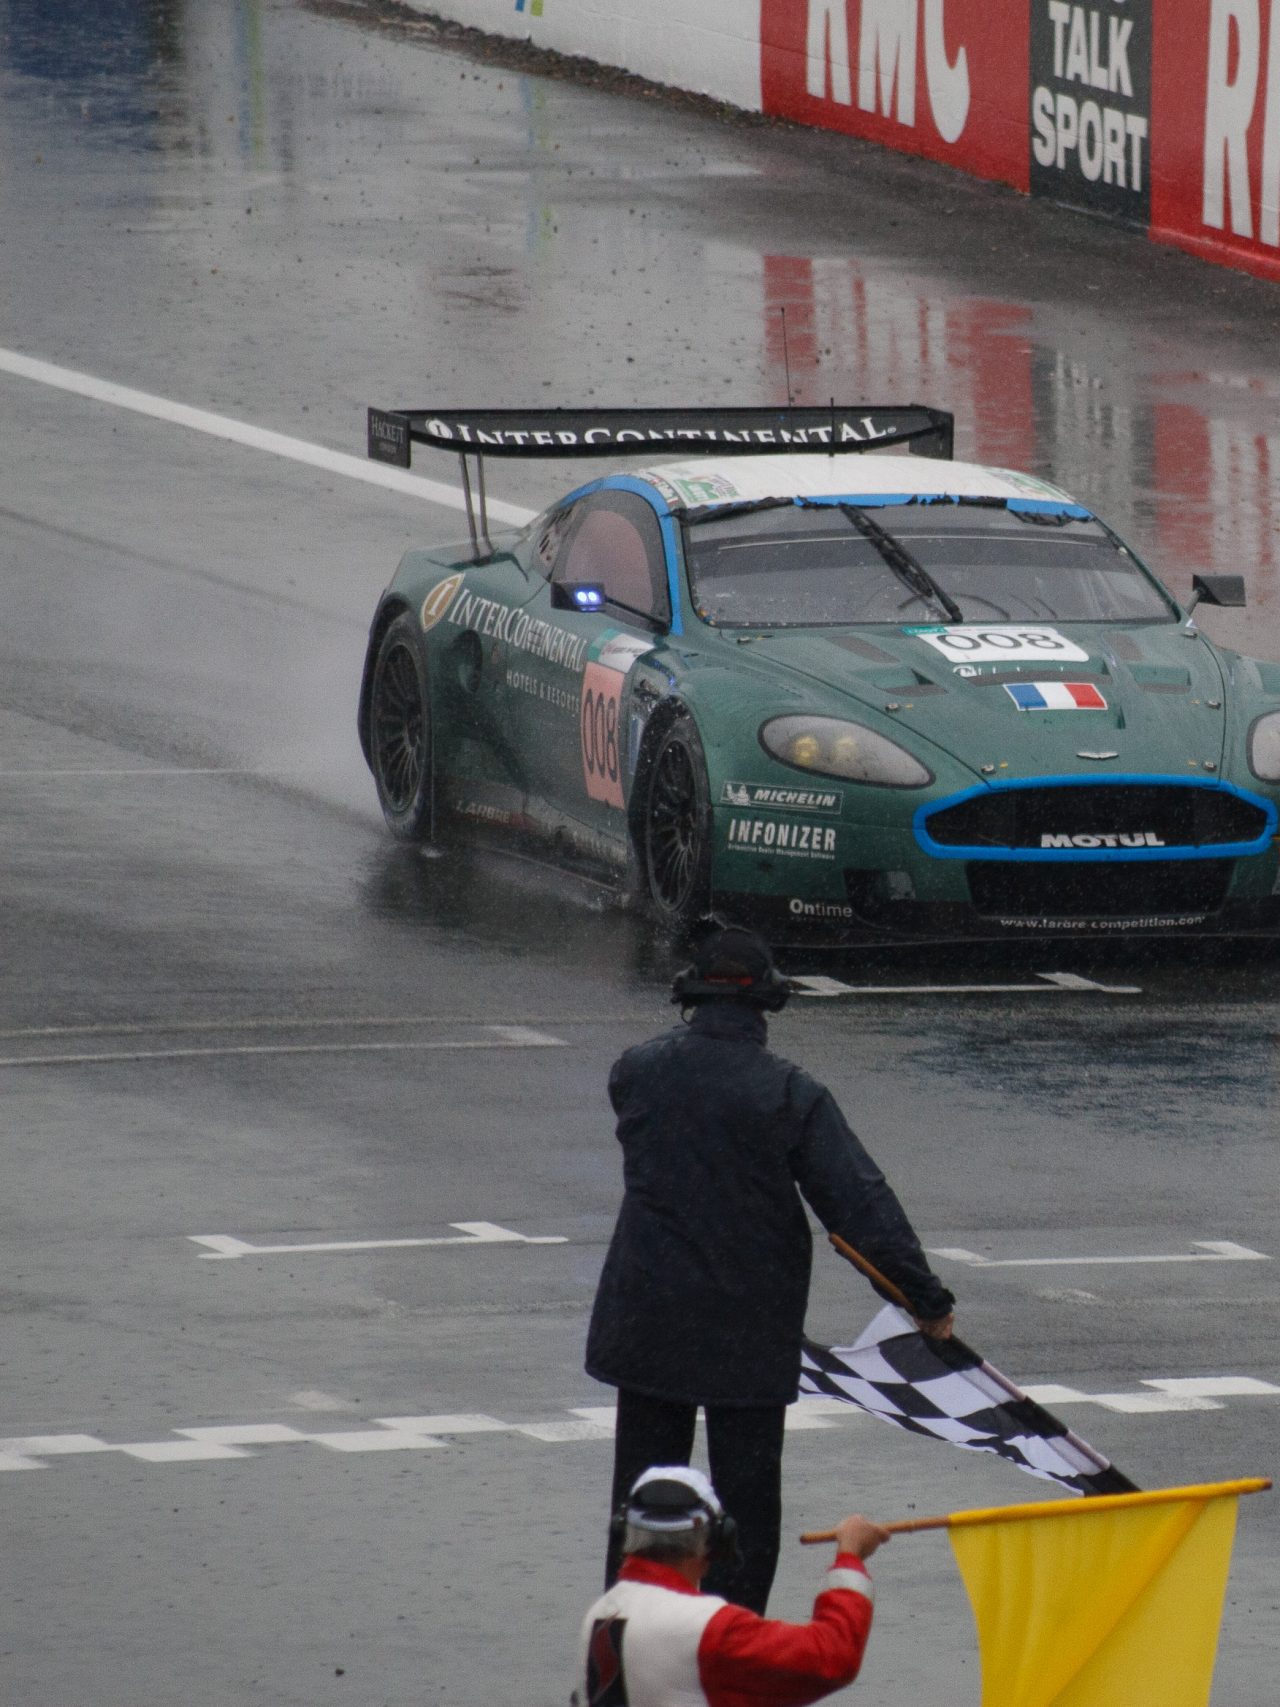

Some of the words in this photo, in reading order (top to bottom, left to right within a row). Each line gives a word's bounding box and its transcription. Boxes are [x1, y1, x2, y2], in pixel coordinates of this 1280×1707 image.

[1048, 1, 1133, 98] TALK
[1032, 86, 1148, 192] SPORT
[936, 632, 1065, 650] 008
[506, 669, 537, 695] HOTELS
[583, 688, 618, 783] 008
[754, 789, 836, 807] MICHELIN
[729, 819, 836, 851] INFONIZER
[1041, 832, 1165, 848] MOTUL
[789, 899, 853, 918] Ontime
[1000, 915, 1206, 931] www.larbrecompetition.com
